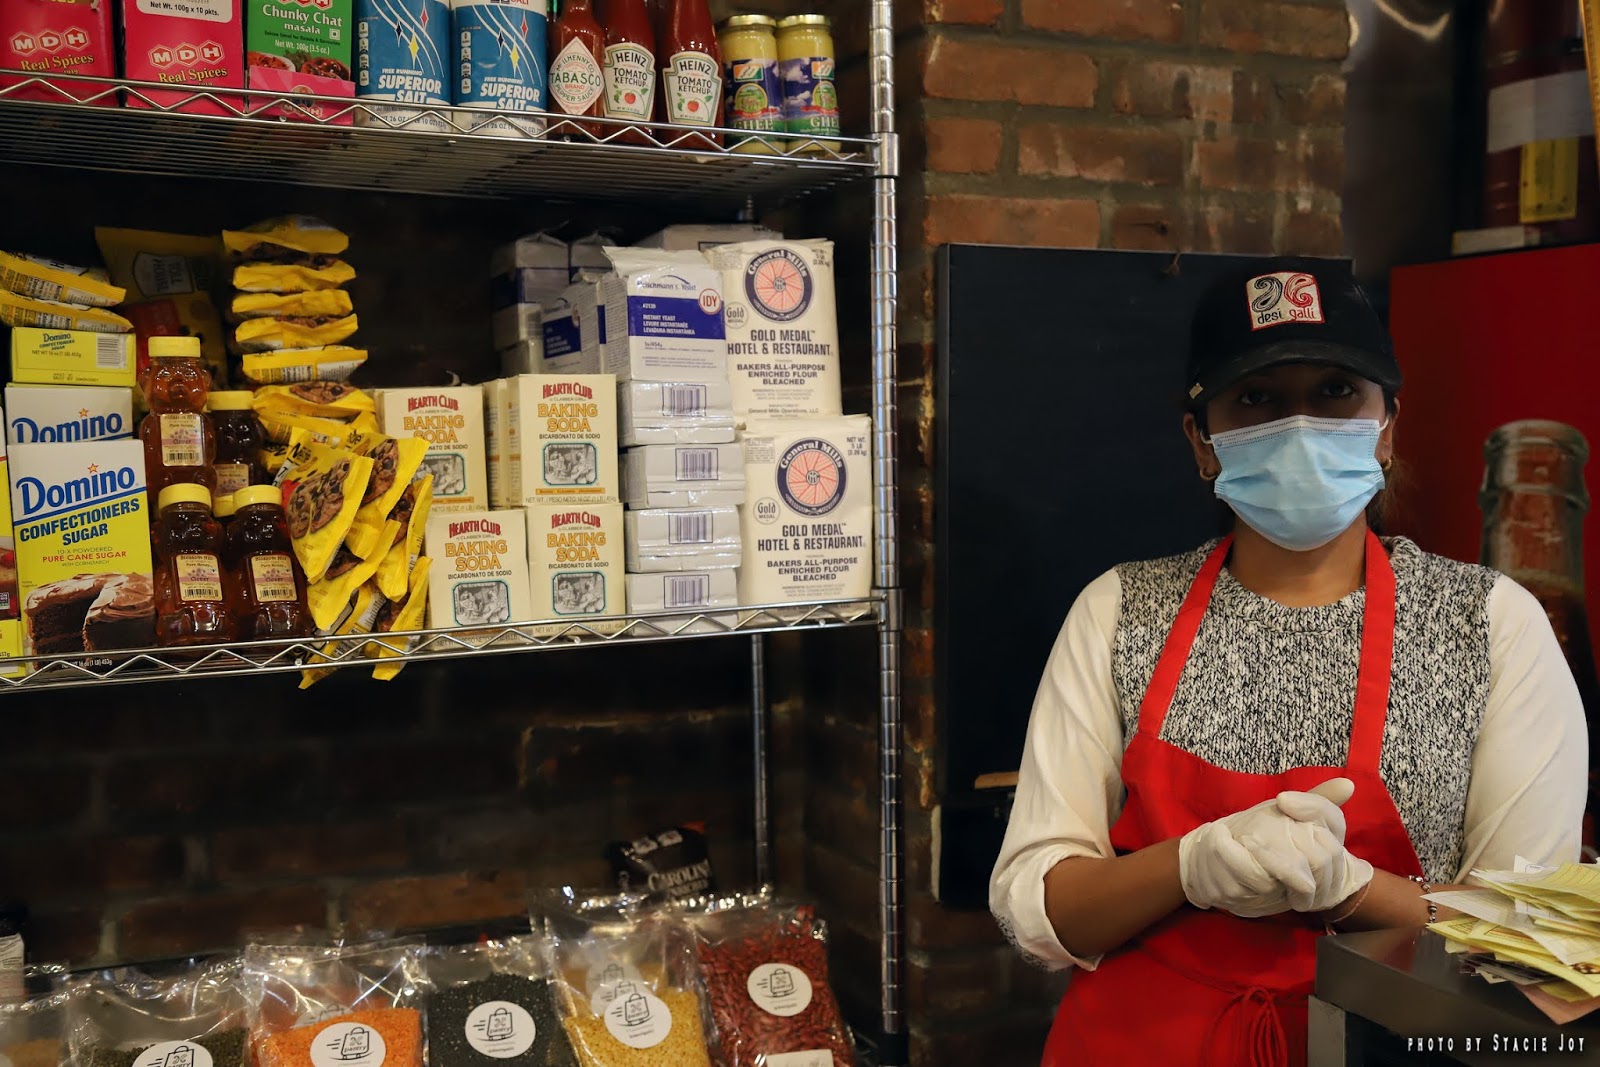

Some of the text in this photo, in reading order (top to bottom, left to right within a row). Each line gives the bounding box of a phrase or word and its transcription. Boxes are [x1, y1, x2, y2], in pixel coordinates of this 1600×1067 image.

[150, 1, 162, 9] Net
[174, 4, 190, 13] 100g
[204, 8, 220, 16] pkts.
[262, 4, 310, 24] Chunky
[313, 11, 343, 27] Chat
[284, 23, 321, 35] masala
[13, 32, 86, 51] MDH
[21, 54, 94, 71] Real Spices
[153, 47, 220, 63] MDH
[616, 51, 647, 68] HEINZ
[613, 67, 648, 81] TOMATO
[679, 60, 712, 75] HEINZ
[158, 68, 228, 84] Real Spices
[549, 71, 600, 87] TABASCO
[615, 76, 647, 88] KETCHUP
[677, 75, 713, 89] TOMATO
[378, 74, 442, 95] SUPERIOR
[678, 85, 711, 95] KETCHUP
[396, 90, 427, 103] SALT
[480, 82, 540, 103] SUPERIOR
[555, 83, 594, 102] PEPPER SAUCE
[497, 98, 527, 111] SALT
[734, 118, 774, 131] GHEE
[810, 116, 839, 128] GHE
[747, 249, 785, 276] General
[786, 252, 808, 278] Mills
[681, 283, 697, 291] Yeast
[702, 295, 718, 307] IDY
[726, 307, 745, 318] Gold
[1257, 307, 1316, 325] desi galli
[43, 332, 72, 343] Domino
[750, 329, 776, 341] GOLD
[727, 342, 758, 355] HOTEL
[761, 342, 769, 355] &
[772, 342, 831, 356] RESTAURANT
[736, 363, 826, 371] BAKERS ALL-PURPOSE
[542, 381, 593, 400] HEARTH CLUB
[407, 394, 459, 412] HEARTH CLUB
[537, 403, 598, 417] BAKING
[11, 409, 123, 443] Domino
[403, 415, 465, 430] BAKING
[547, 417, 592, 432] SODA
[780, 440, 819, 469] General
[821, 442, 843, 468] Mills
[16, 464, 136, 515] Domino
[757, 502, 776, 514] Gold
[19, 497, 140, 543] CONFECTIONERS
[551, 511, 601, 529] HEARTH CLUB
[62, 522, 108, 546] SUGAR
[448, 519, 501, 538] HEARTH CLUB
[782, 524, 808, 537] GOLD
[546, 532, 607, 548] BAKING
[757, 535, 863, 552] HOTEL & RESTAURANT
[72, 546, 113, 554] POWDERED
[444, 540, 508, 557] BAKING
[555, 546, 600, 562] SODA
[42, 551, 127, 563] PURE CANE SUGAR
[455, 555, 502, 572] SODA
[767, 557, 858, 568] BAKERS ALL-PURPOSE
[548, 562, 585, 570] BICARBONATO
[778, 565, 850, 575] ENRICHED FLOUR
[447, 571, 487, 580] BICARBONATO
[792, 573, 837, 582] BLEACHED
